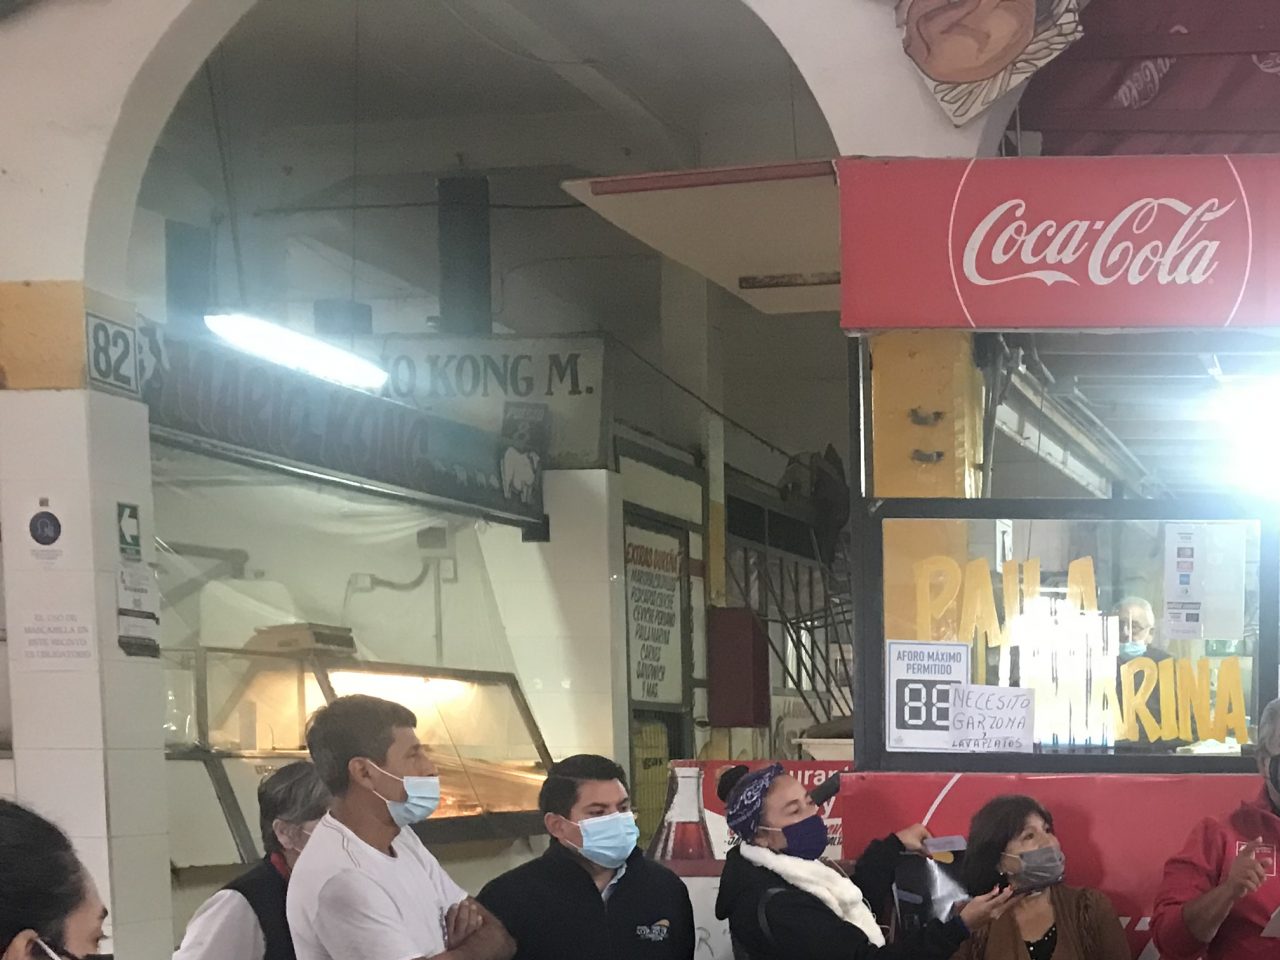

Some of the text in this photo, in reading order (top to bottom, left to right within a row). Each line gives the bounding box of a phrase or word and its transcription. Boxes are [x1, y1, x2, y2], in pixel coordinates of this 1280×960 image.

[962, 196, 1238, 287] Coca-Cola
[93, 322, 132, 387] 82
[427, 353, 535, 398] KONG
[544, 352, 595, 396] M.
[896, 649, 925, 662] AFORO
[906, 663, 952, 675] PERMITIDO
[952, 687, 1031, 711] NECESITO
[1090, 655, 1249, 746] ARINA
